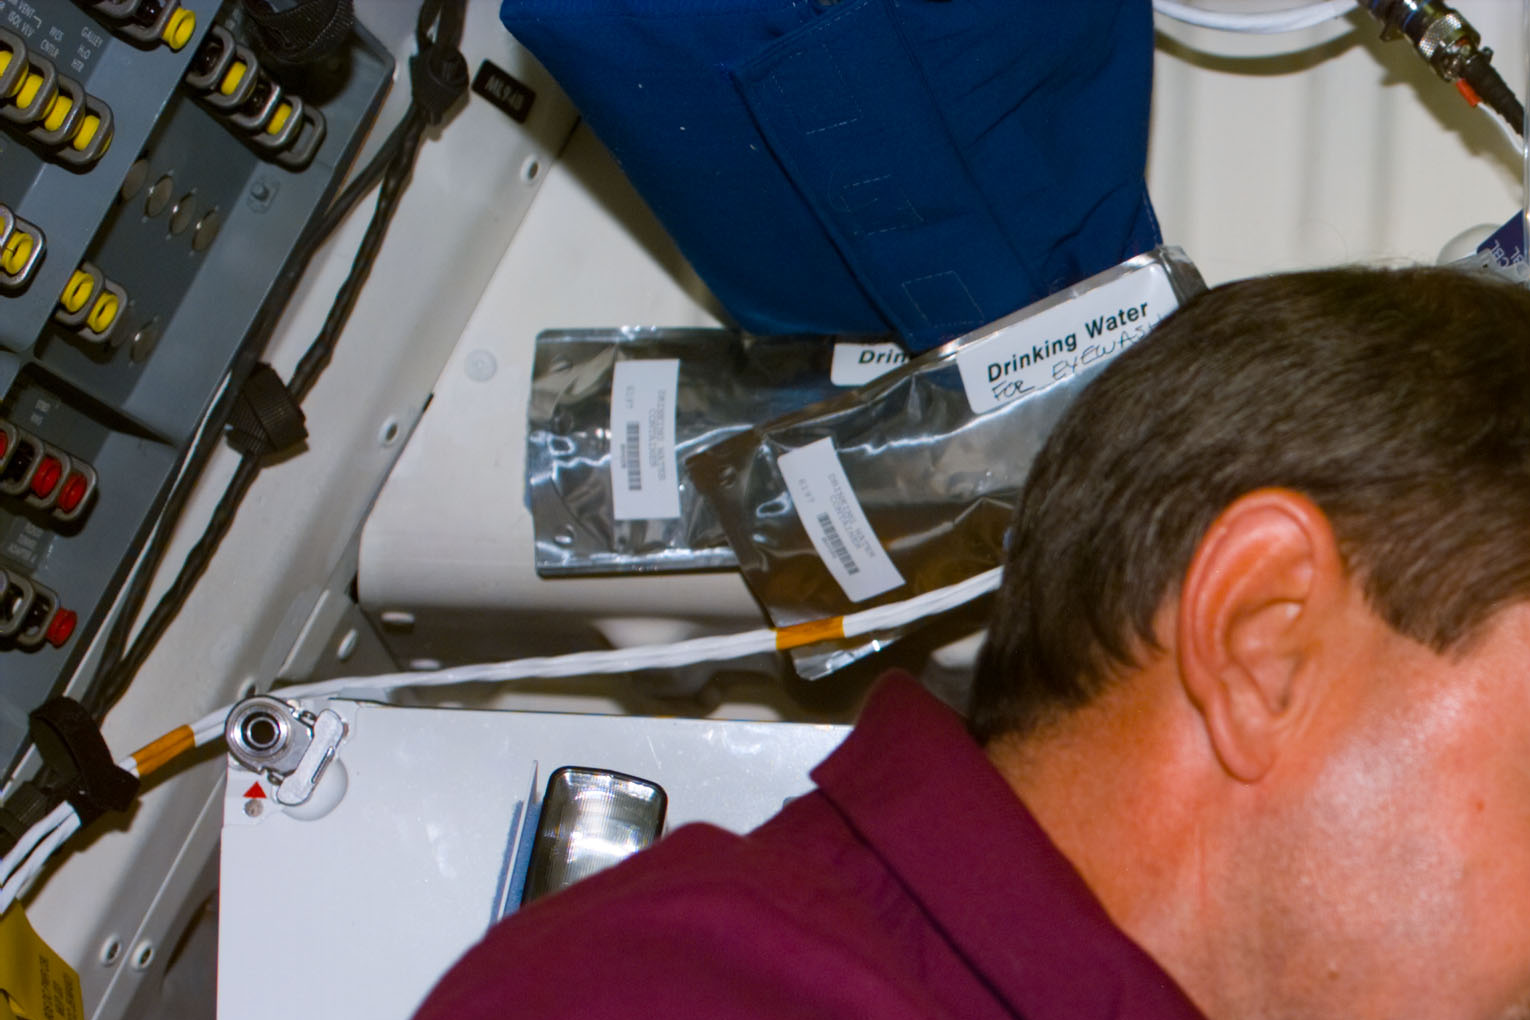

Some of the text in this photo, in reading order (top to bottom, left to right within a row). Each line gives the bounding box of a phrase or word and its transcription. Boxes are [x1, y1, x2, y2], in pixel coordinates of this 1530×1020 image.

[987, 301, 1150, 383] Drinking Water
[858, 349, 911, 365] Drin
[991, 379, 1035, 401] FOR
